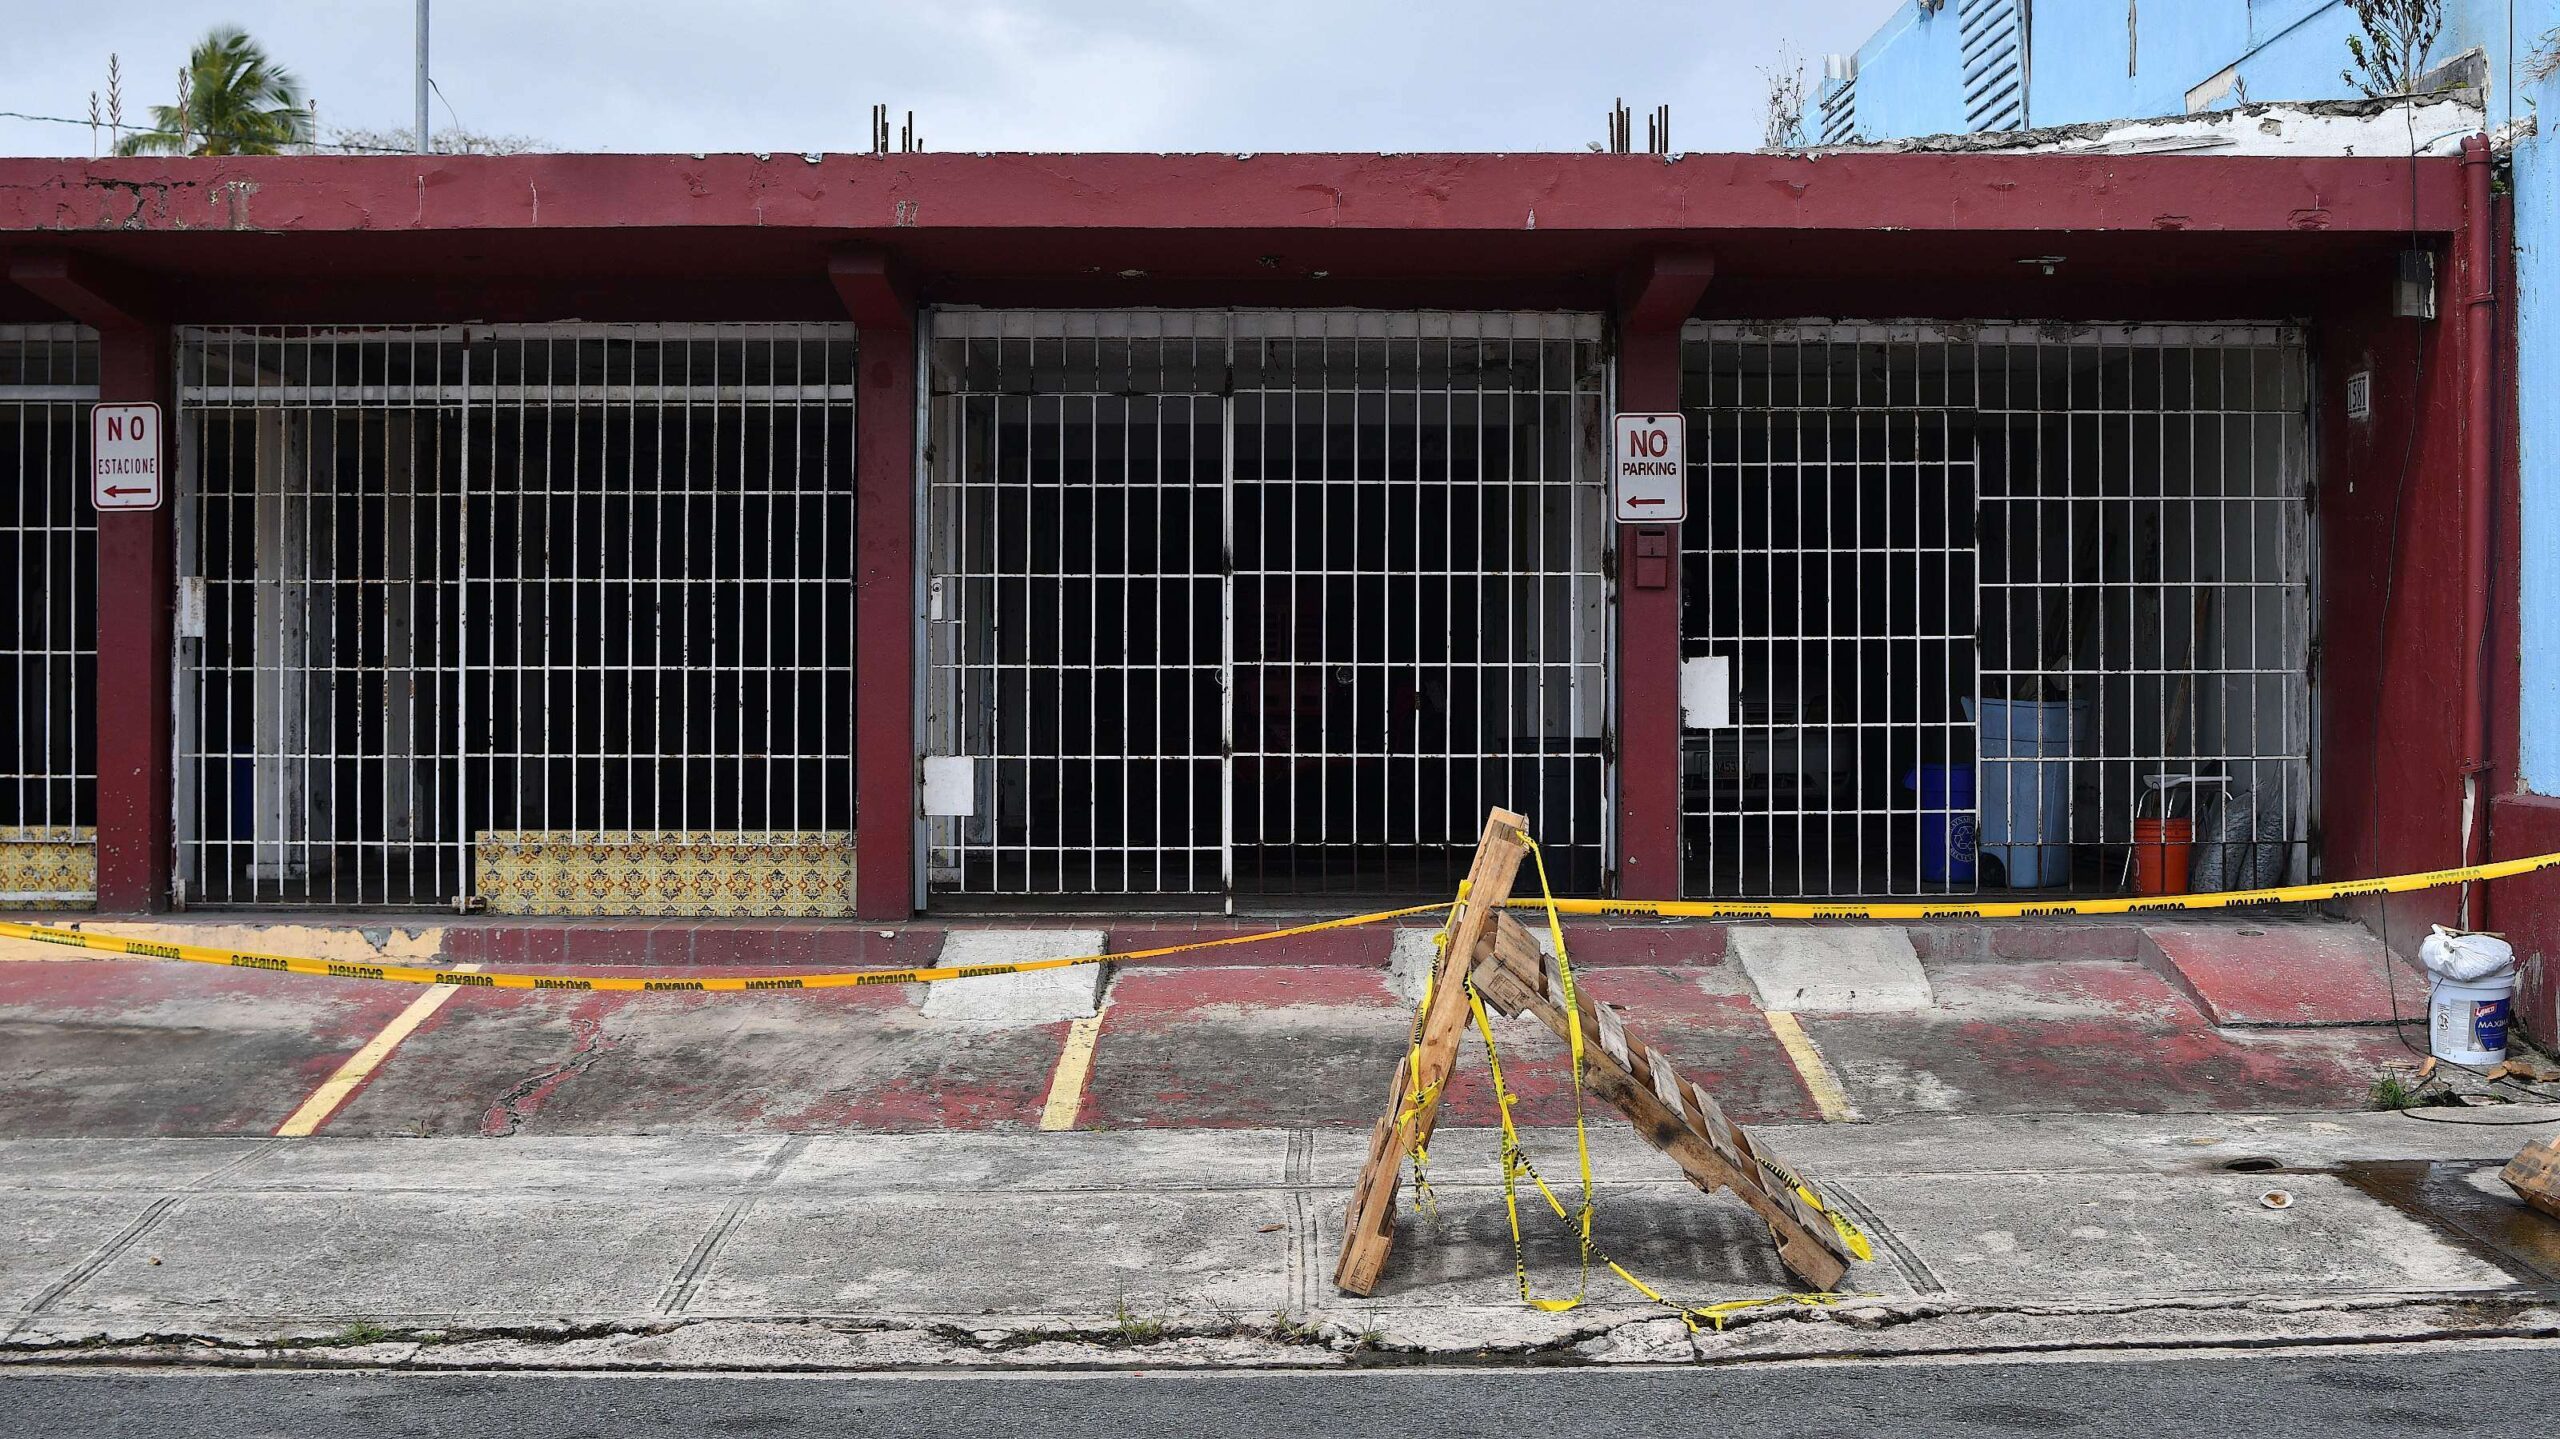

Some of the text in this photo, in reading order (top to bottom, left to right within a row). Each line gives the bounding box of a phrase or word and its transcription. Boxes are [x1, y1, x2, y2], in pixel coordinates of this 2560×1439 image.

[107, 415, 145, 441] NO
[1630, 429, 1668, 458] NO
[98, 457, 155, 475] ESTACIONE
[1622, 462, 1677, 476] PARKING
